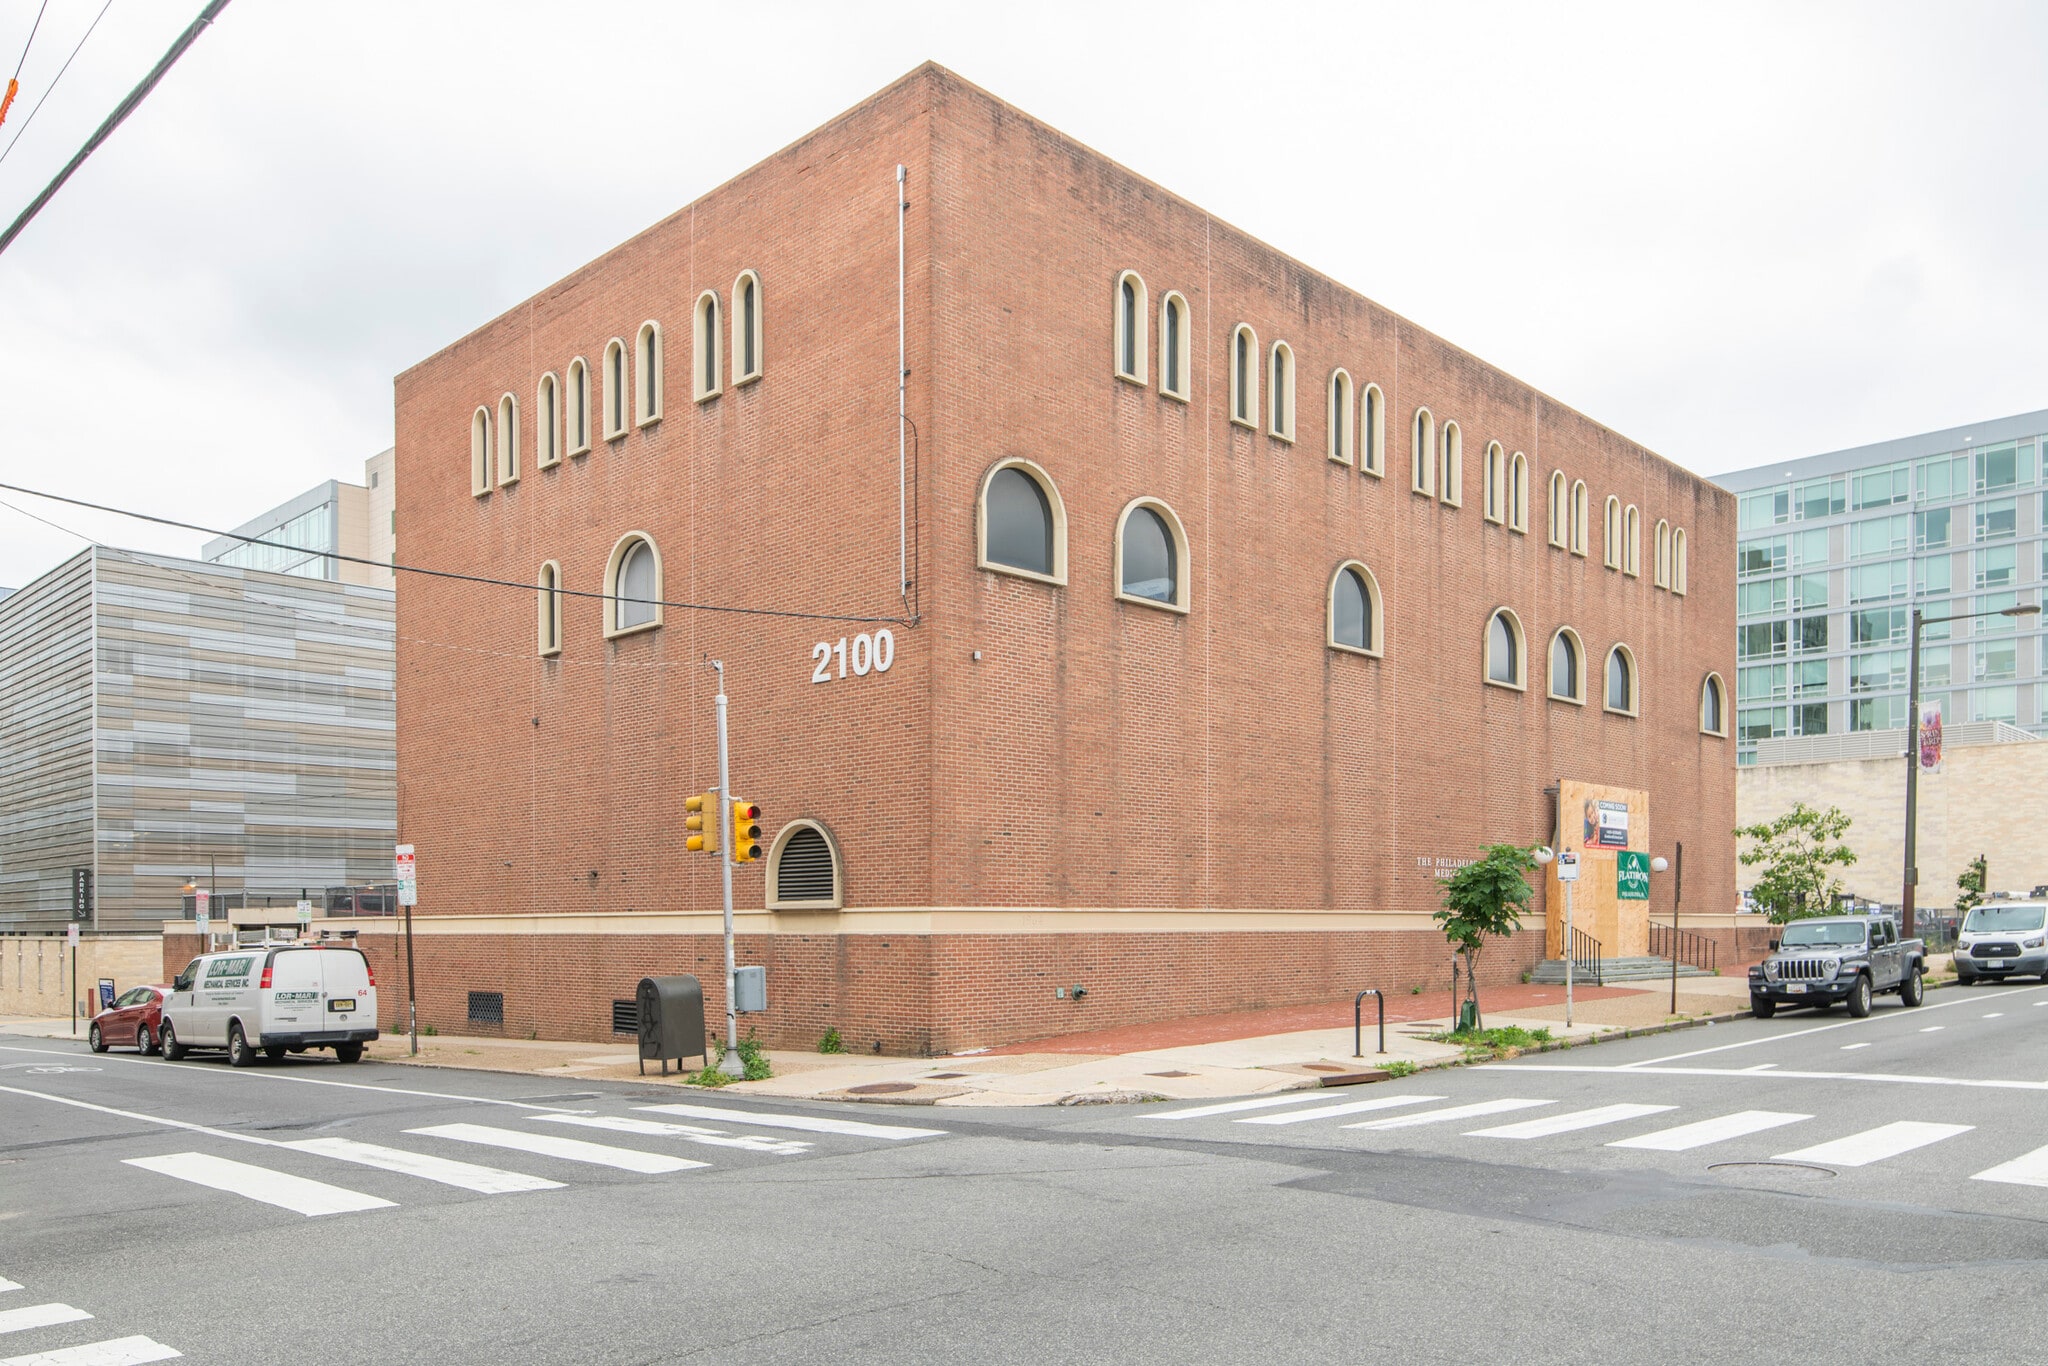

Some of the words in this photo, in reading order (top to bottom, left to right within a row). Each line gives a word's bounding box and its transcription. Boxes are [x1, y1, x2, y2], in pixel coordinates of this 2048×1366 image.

[812, 629, 895, 684] 2100
[1600, 801, 1615, 810] COMING
[1615, 803, 1627, 811] SOON
[1417, 857, 1432, 866] THE
[1618, 870, 1648, 882] FLATIRON
[208, 959, 247, 976] LOR-MAR
[276, 992, 311, 1000] LOR-MAR
